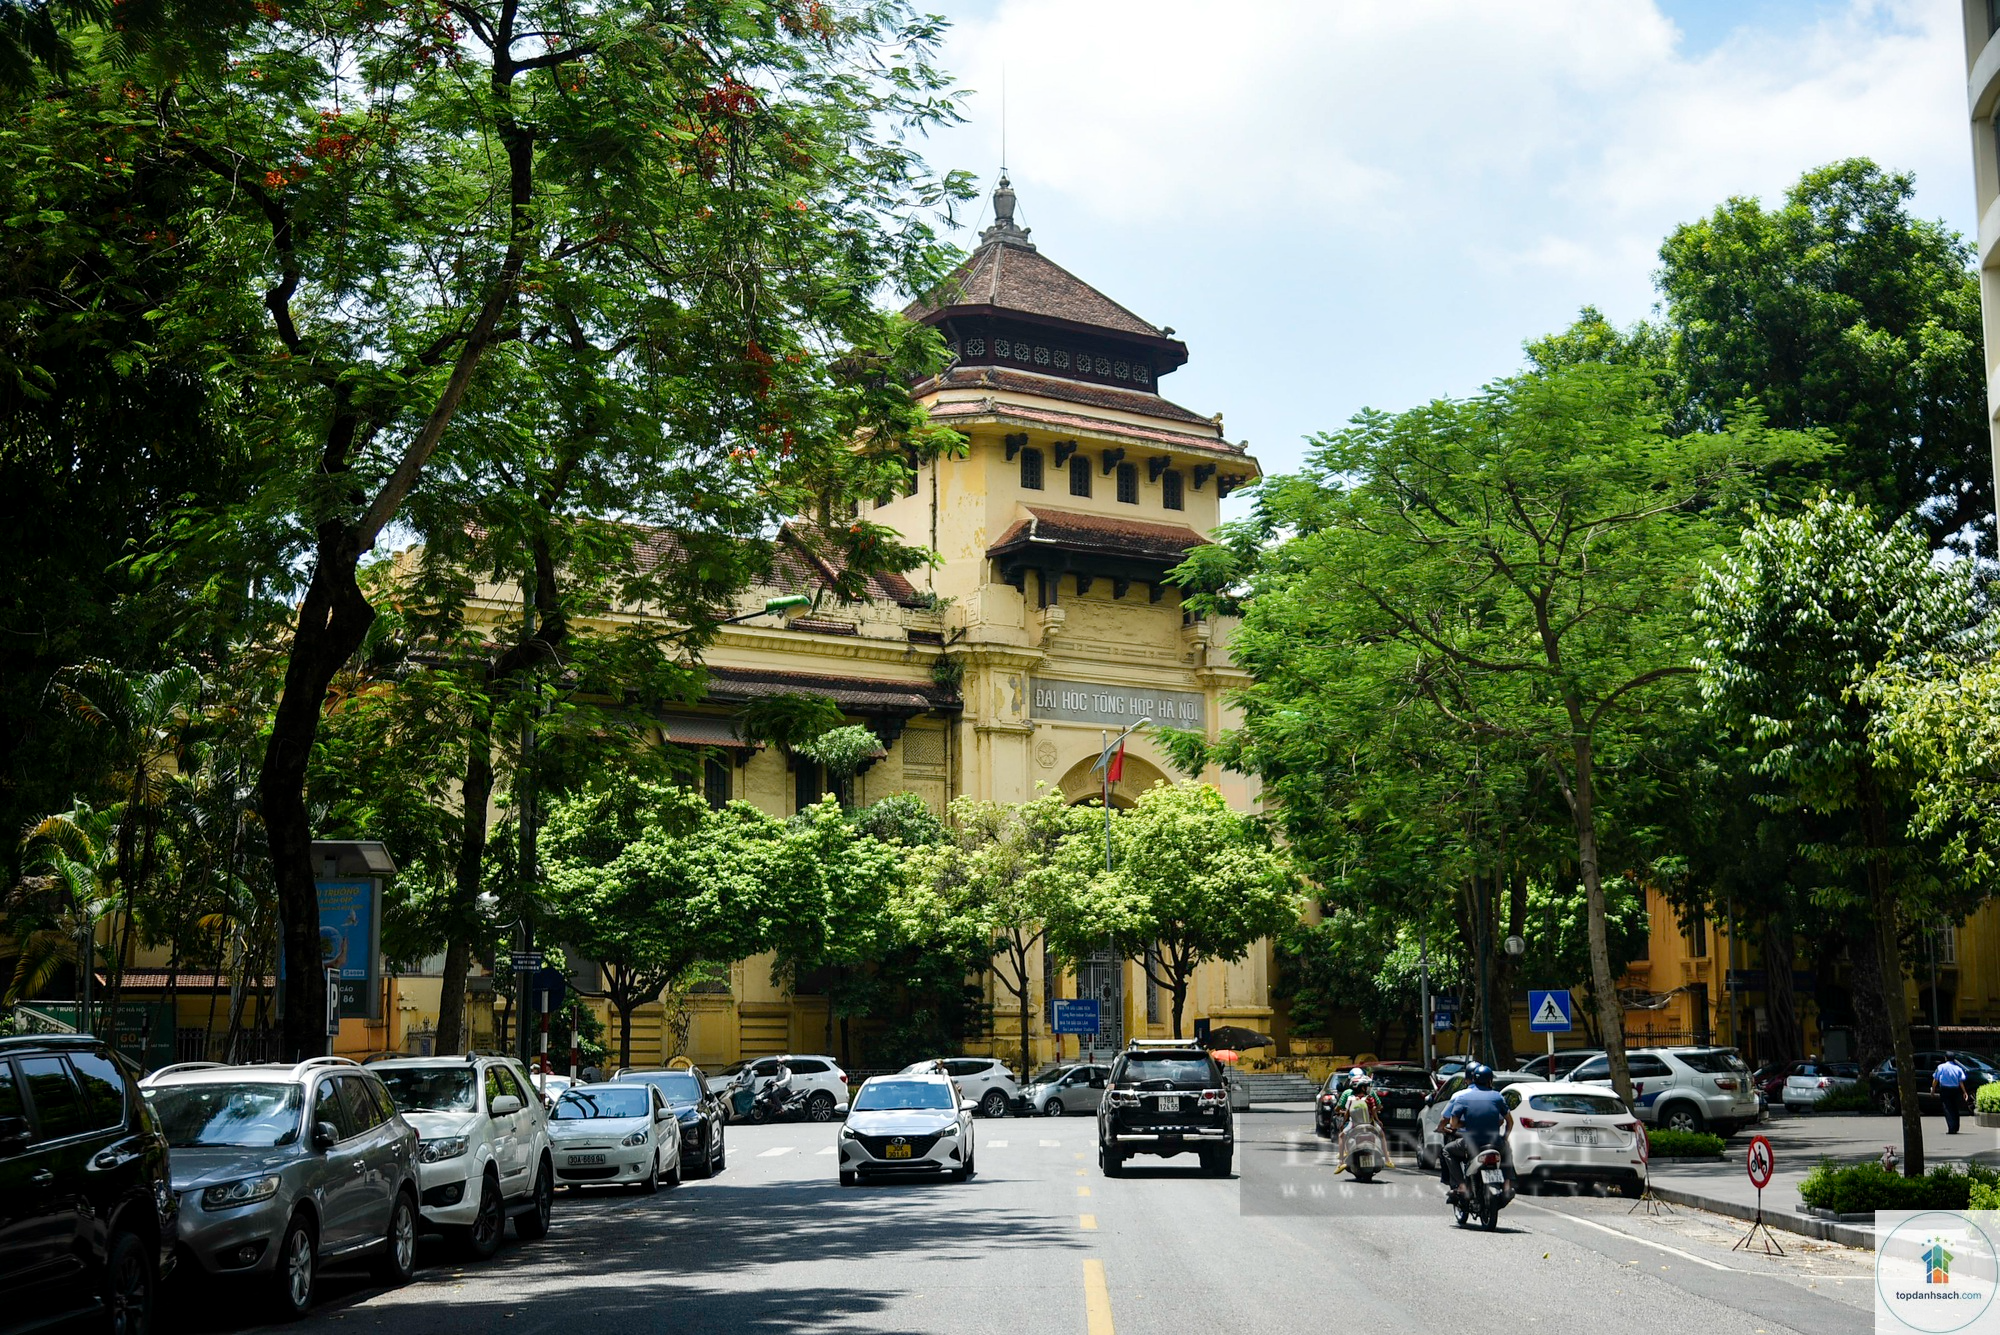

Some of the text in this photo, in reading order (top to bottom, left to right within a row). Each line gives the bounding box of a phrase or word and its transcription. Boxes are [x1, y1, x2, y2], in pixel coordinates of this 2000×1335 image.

[1035, 688, 1057, 711] ĐẠI
[1062, 691, 1088, 714] HỌC
[1091, 691, 1124, 714] TỔNG
[1158, 698, 1175, 719] HÀ
[1179, 699, 1198, 722] NỘI
[120, 1033, 137, 1043] 60
